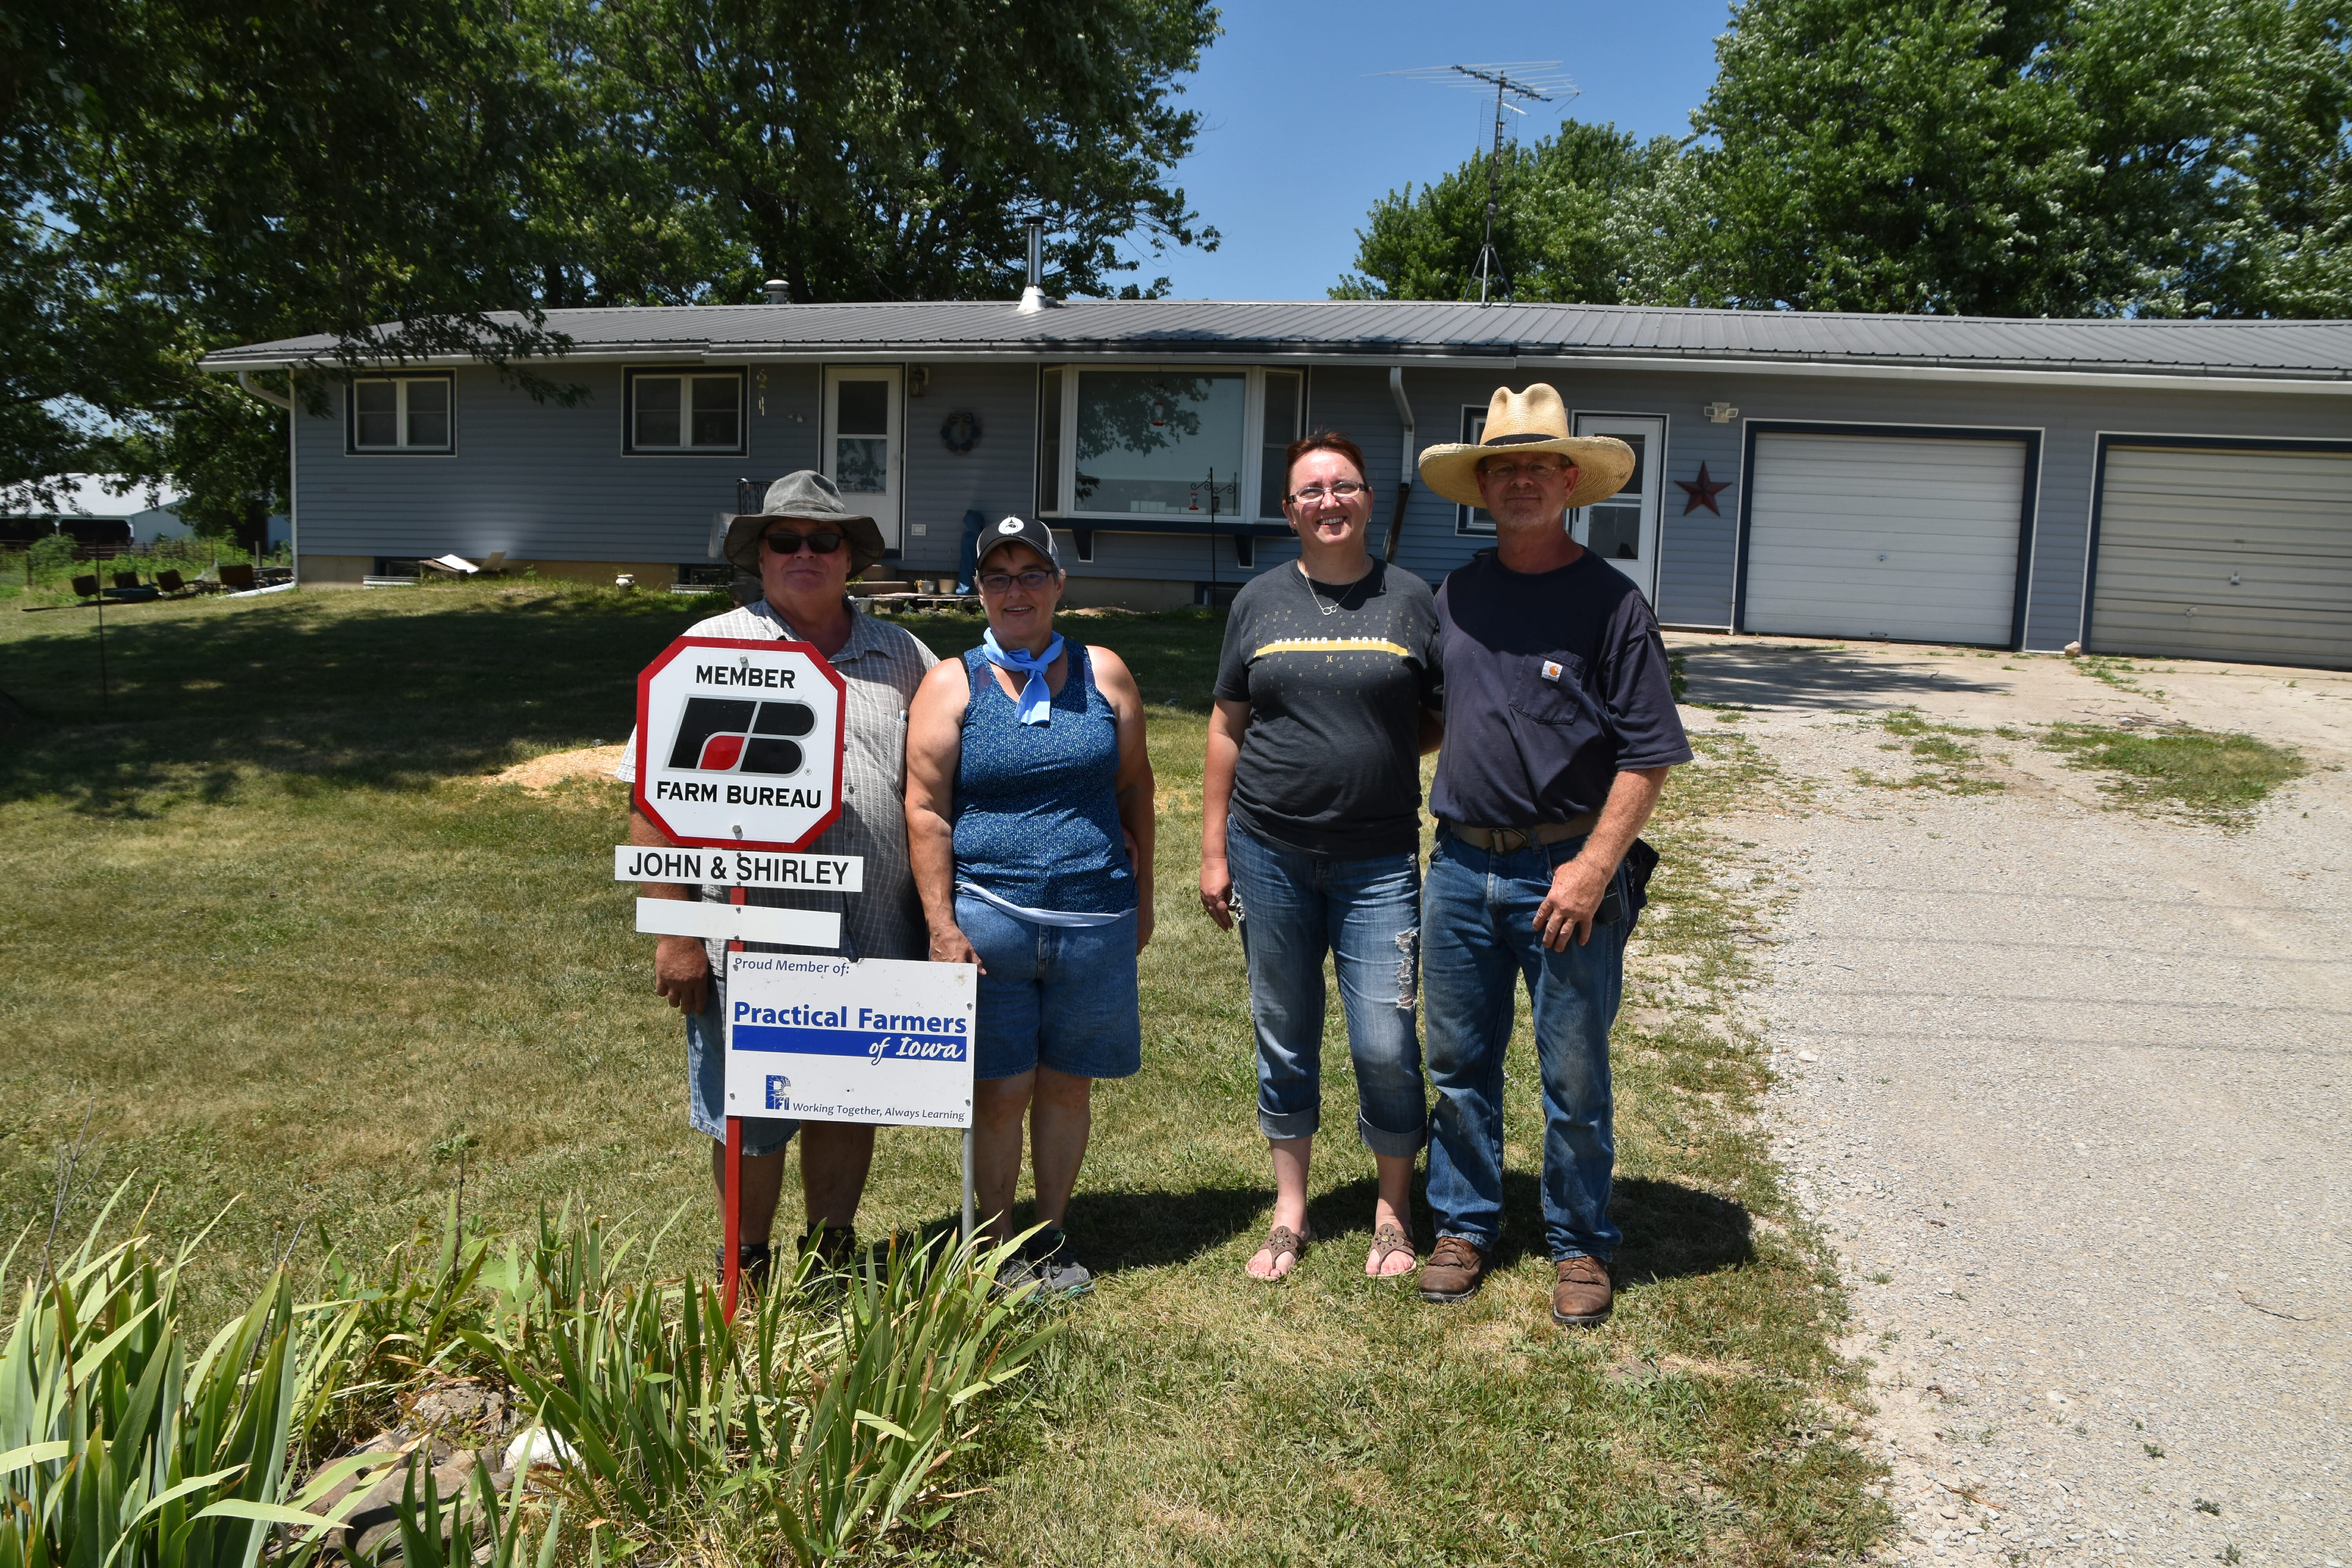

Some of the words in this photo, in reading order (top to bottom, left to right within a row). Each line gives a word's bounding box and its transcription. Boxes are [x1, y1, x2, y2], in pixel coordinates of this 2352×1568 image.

[1274, 637, 1327, 646] MAKING
[696, 664, 795, 689] MEMBER
[657, 780, 717, 802] FARM
[726, 785, 822, 809] BUREAU
[629, 852, 701, 878] JOHN
[711, 856, 727, 879] &
[736, 857, 849, 885] SHIRLEY
[734, 958, 773, 970] Proud
[775, 960, 829, 973] Member
[833, 962, 849, 977] of:
[734, 1002, 847, 1027] Practical
[859, 1008, 967, 1034] Farmers
[869, 1037, 891, 1065] of
[896, 1036, 963, 1058] Iowa
[793, 1103, 835, 1116] Working
[837, 1105, 882, 1117] Together,
[884, 1107, 920, 1119] Always
[922, 1109, 965, 1122] Learning
